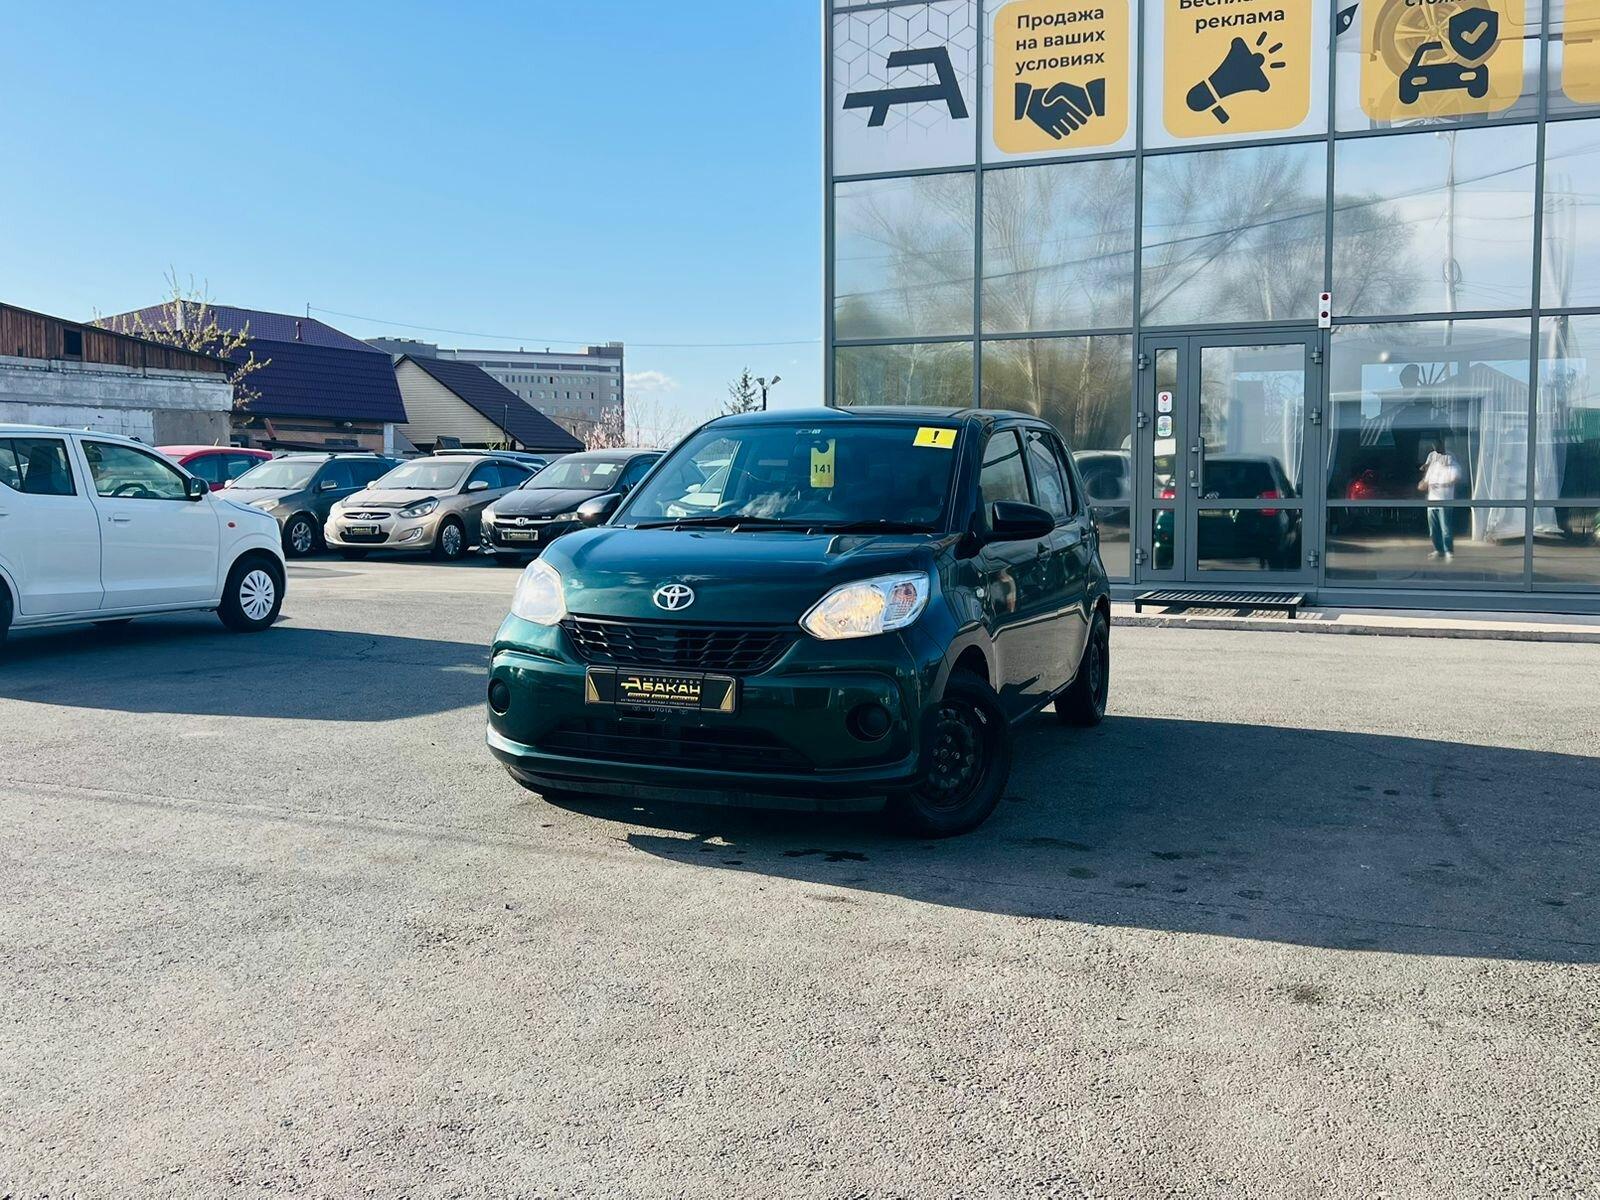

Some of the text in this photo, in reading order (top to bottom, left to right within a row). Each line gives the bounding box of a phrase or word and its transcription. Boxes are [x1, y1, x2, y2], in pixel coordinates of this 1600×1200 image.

[1017, 8, 1104, 30] Продажа
[1195, 9, 1285, 33] реклама
[1016, 30, 1105, 50] на ваших
[1015, 52, 1105, 76] условиях
[814, 464, 831, 473] 141
